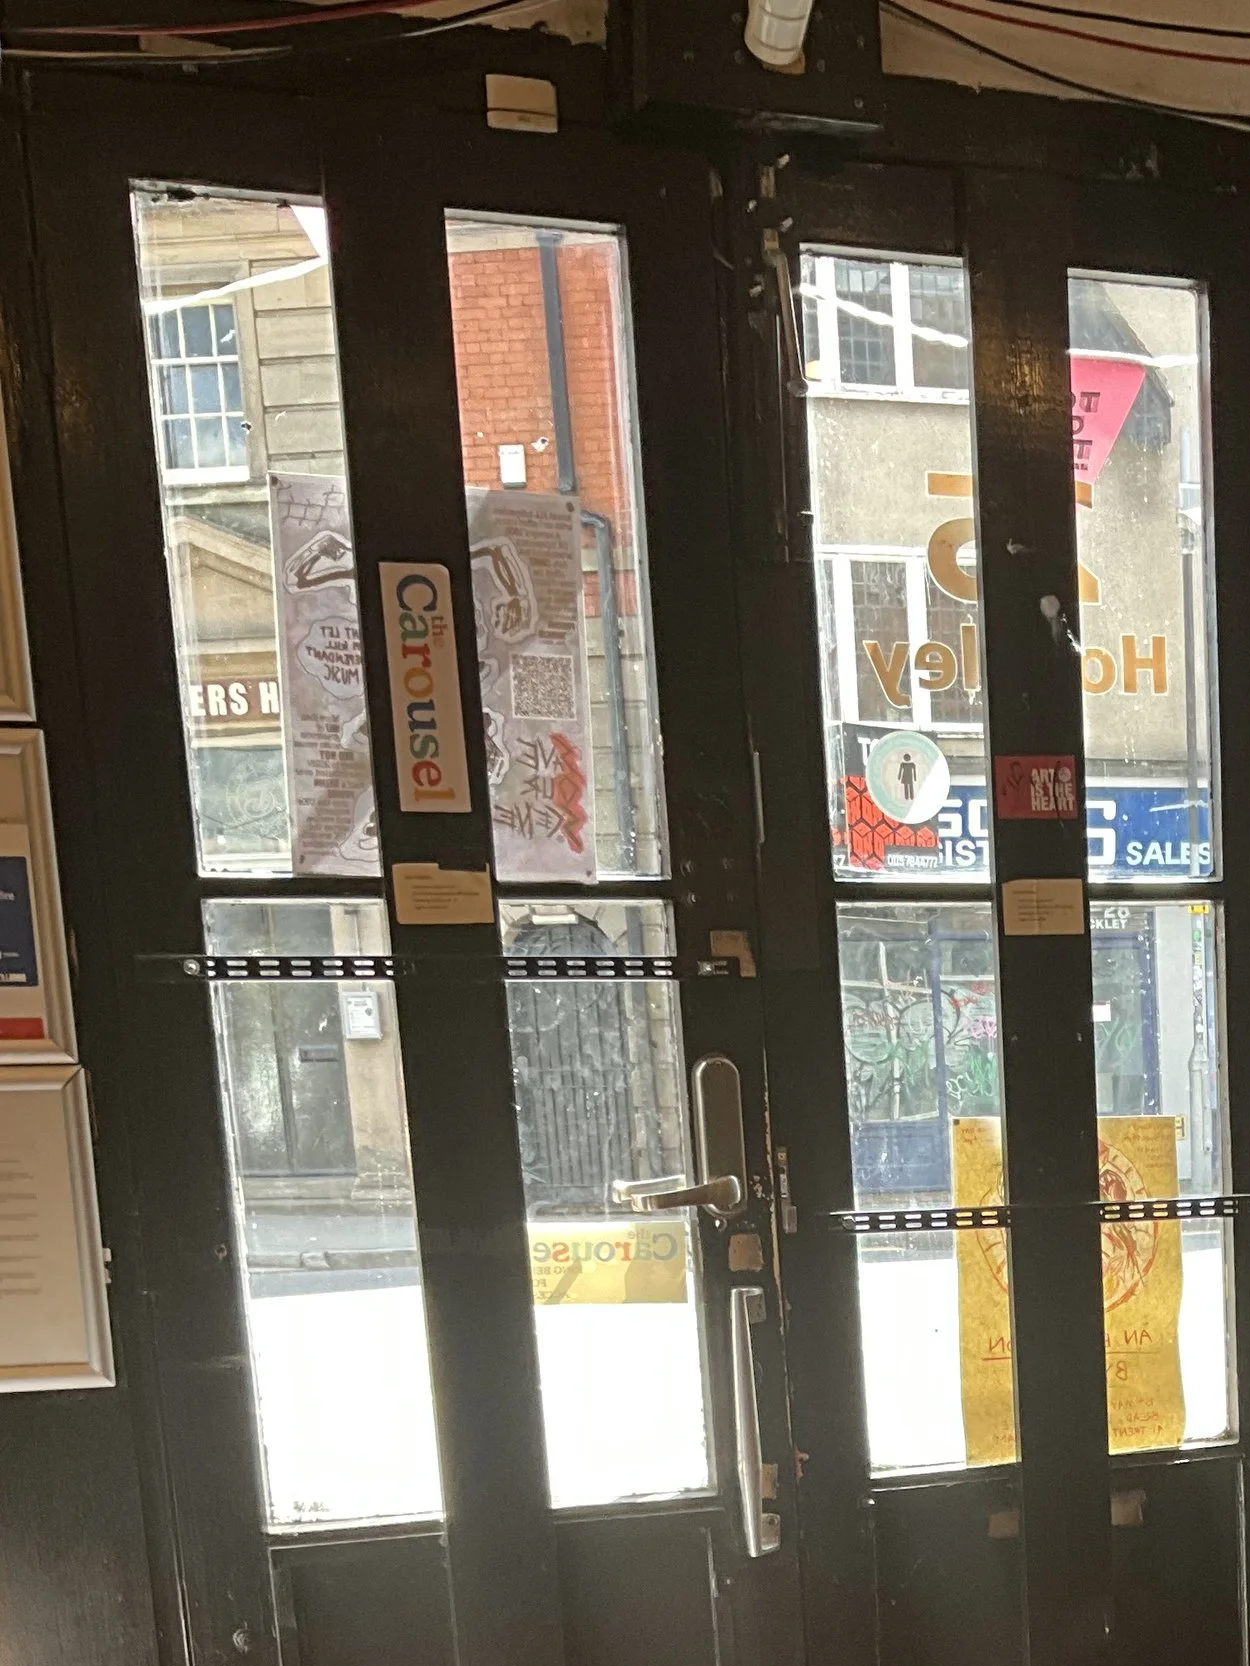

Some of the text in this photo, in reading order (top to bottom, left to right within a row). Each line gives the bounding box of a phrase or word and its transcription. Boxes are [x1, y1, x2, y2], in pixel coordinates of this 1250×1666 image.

[396, 574, 456, 802] Carousel
[189, 681, 280, 717] ERS H
[1031, 768, 1055, 783] ART
[1030, 782, 1073, 797] IS THE
[1031, 796, 1074, 811] HEART
[1126, 841, 1210, 866] SALES
[1090, 918, 1128, 930] CKLEY
